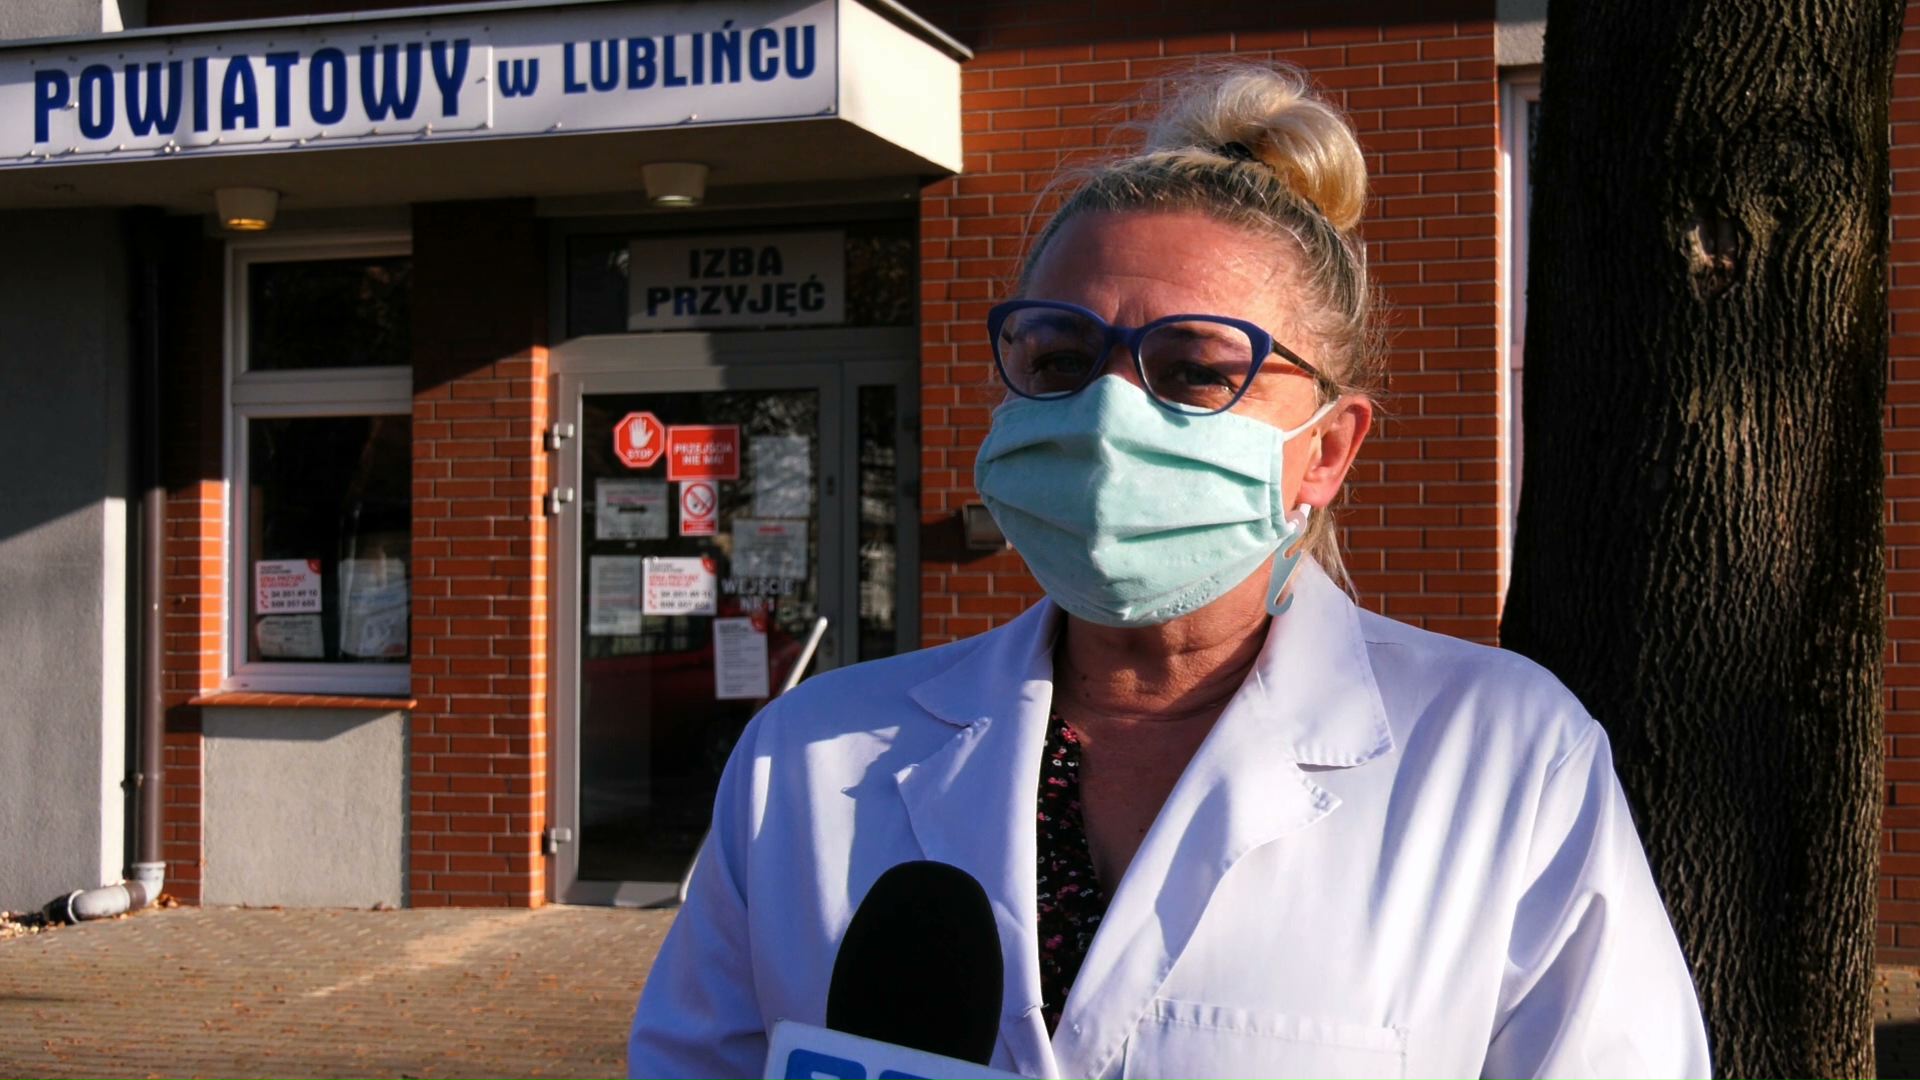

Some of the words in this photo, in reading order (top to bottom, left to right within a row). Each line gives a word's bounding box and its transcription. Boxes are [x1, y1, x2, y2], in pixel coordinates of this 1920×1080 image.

[34, 38, 471, 143] POWIATOWY
[562, 19, 816, 95] LUBLIŃCU
[688, 246, 783, 279] IZBA
[646, 273, 826, 317] PRZYJĘĆ
[626, 449, 653, 459] STOP
[682, 455, 701, 465] NIE
